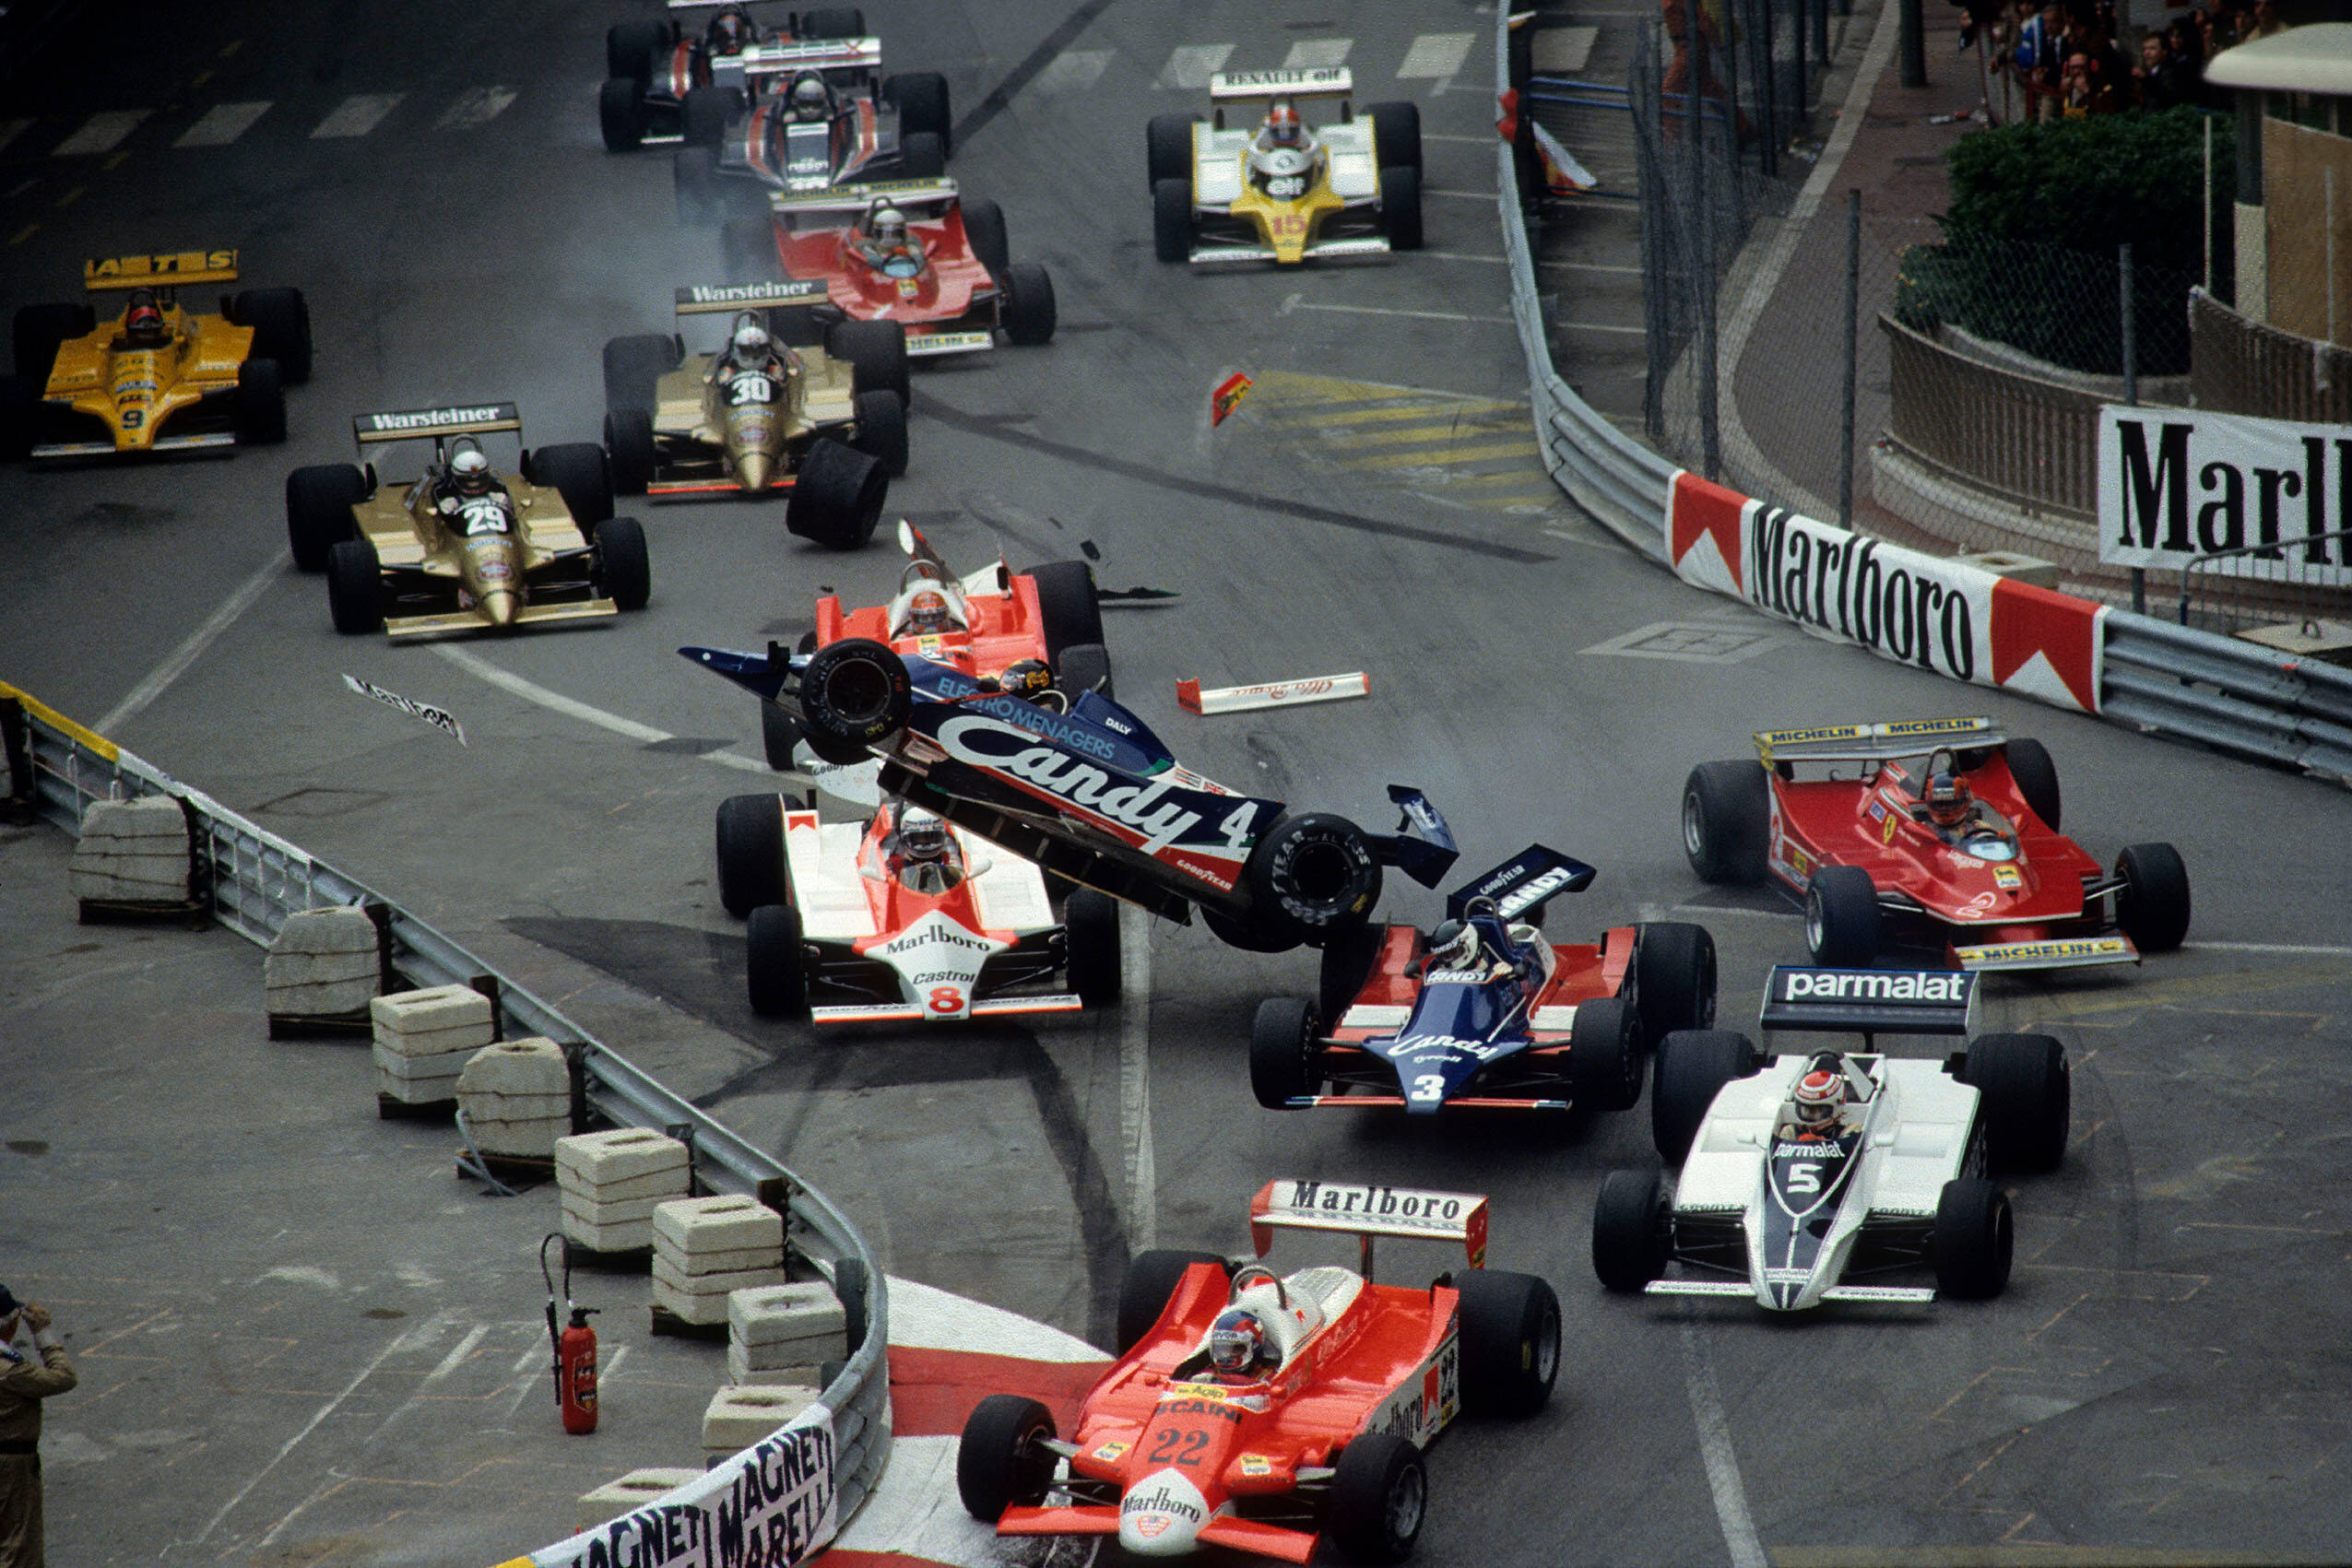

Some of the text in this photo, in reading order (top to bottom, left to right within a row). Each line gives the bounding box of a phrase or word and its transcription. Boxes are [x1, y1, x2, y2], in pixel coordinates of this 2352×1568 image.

[1225, 69, 1339, 86] RENAULT elf
[1272, 214, 1306, 234] 15
[692, 281, 812, 302] Warsteiner
[731, 377, 771, 405] 30
[121, 409, 145, 430] 9
[372, 407, 500, 430] Warsteiner
[464, 506, 507, 535] 29
[1753, 504, 1974, 680] Marlboro
[1105, 717, 1131, 736] DALY
[1771, 727, 1856, 743] MICHELIN
[1890, 720, 1974, 734] MICHELIN
[938, 715, 1201, 855] Candy
[1218, 800, 1259, 849] 4
[1176, 859, 1233, 891] GOODYEAR
[1955, 891, 1997, 918] 2
[886, 925, 991, 954] Marlboro
[1982, 941, 2093, 960] MICHELIN
[912, 971, 975, 985] Castrol
[1785, 972, 1966, 1001] parmalat
[928, 986, 964, 1013] 8
[1387, 1033, 1498, 1060] Candy
[1411, 1074, 1446, 1102] 3
[1771, 1141, 1846, 1160] parmalat
[1787, 1162, 1823, 1193] 5
[1291, 1180, 1460, 1220] Marlboro
[1147, 1428, 1211, 1466] 22
[1122, 1486, 1200, 1523] Marlboro
[571, 1503, 714, 1568] AGNETI
